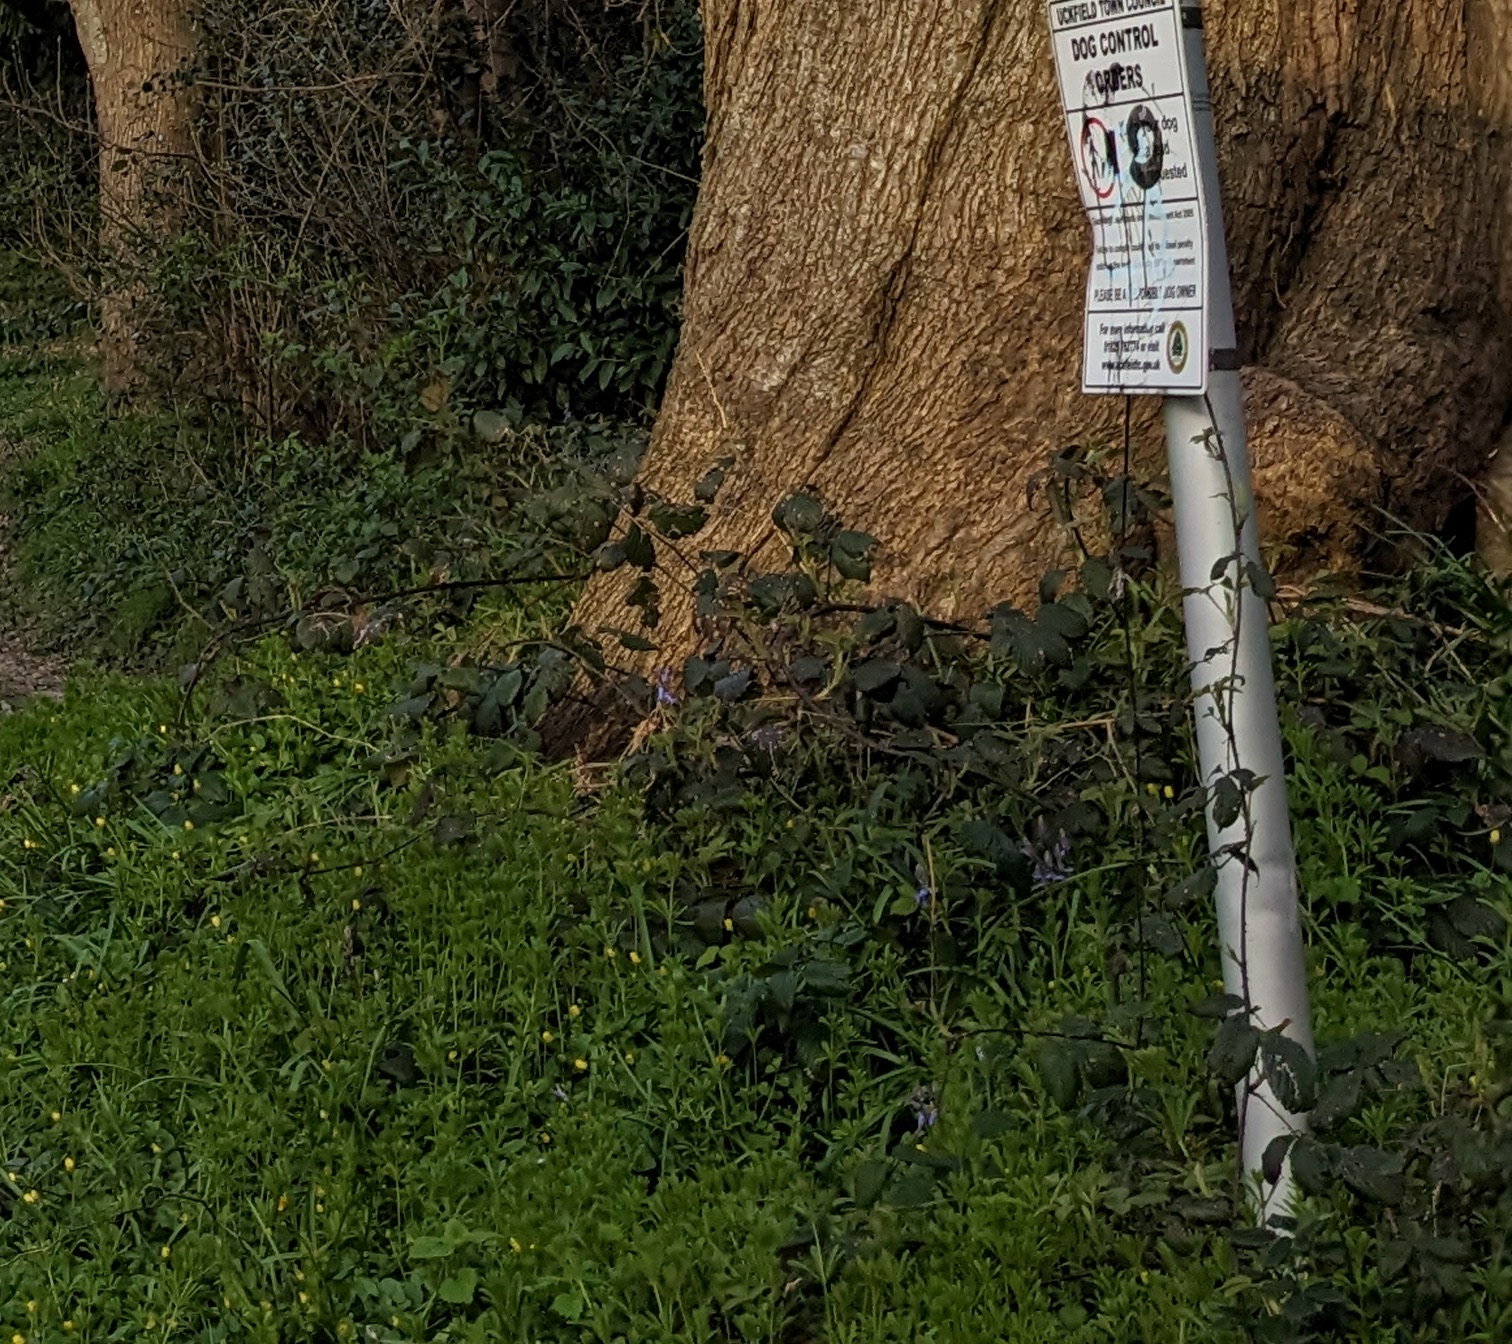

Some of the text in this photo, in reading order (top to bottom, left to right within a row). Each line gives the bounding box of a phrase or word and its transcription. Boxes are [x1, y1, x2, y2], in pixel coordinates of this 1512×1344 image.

[1056, 2, 1098, 26] UCKFIELD
[1071, 23, 1159, 62] DOG CONTROL
[1094, 63, 1143, 94] ORDERS
[1161, 115, 1178, 132] dog
